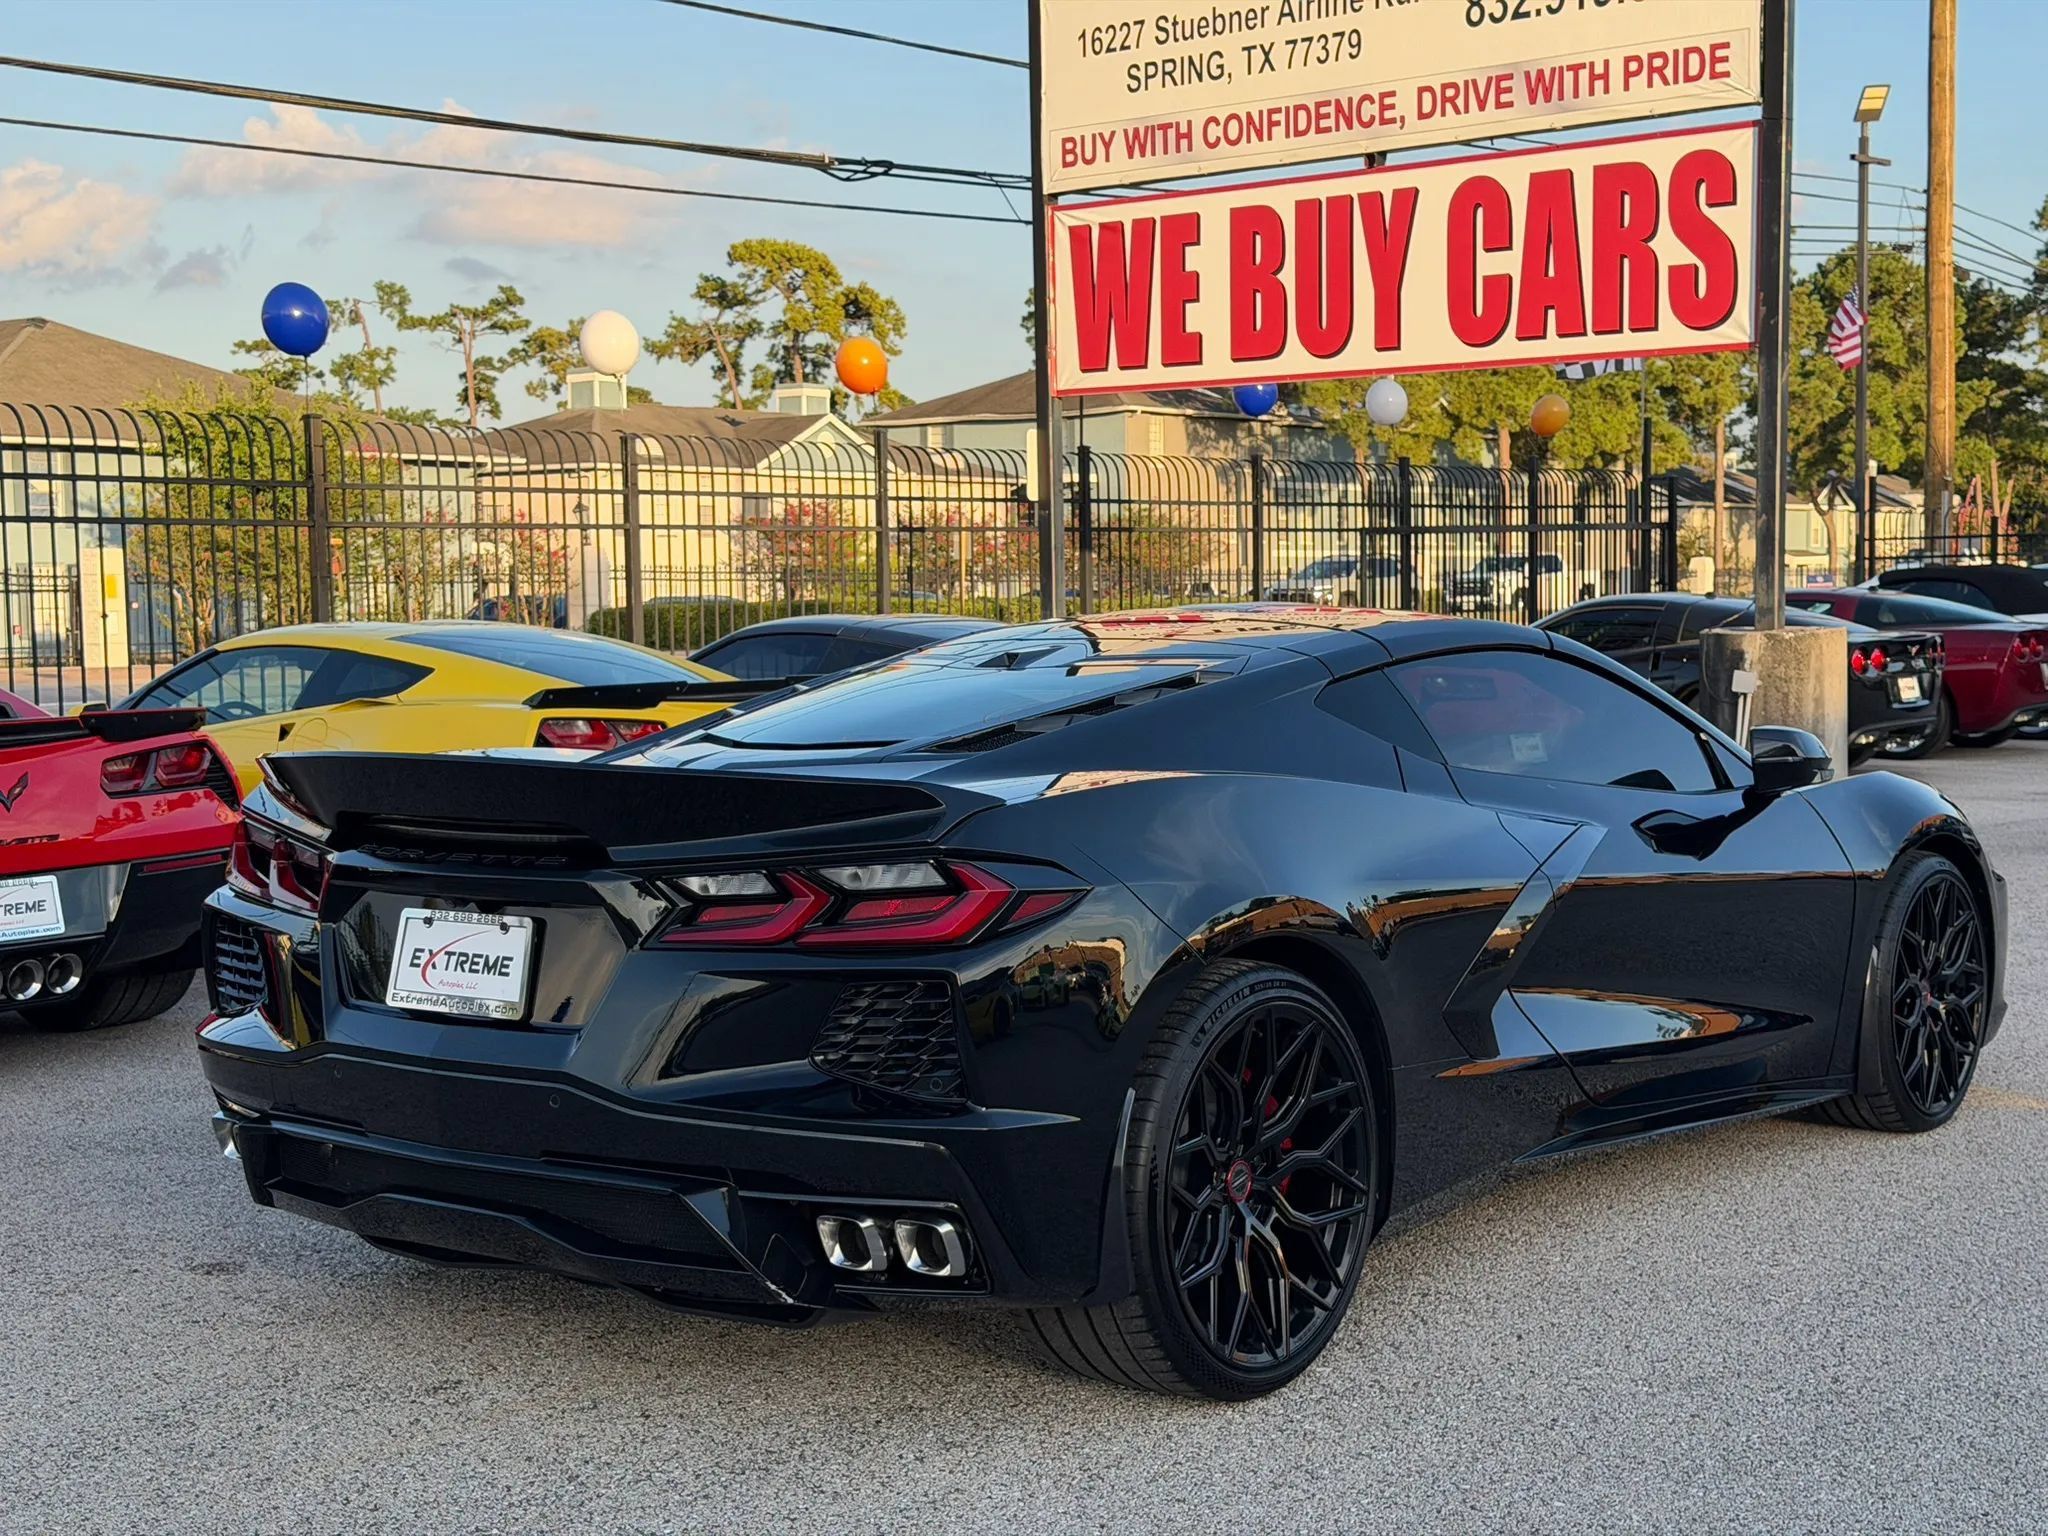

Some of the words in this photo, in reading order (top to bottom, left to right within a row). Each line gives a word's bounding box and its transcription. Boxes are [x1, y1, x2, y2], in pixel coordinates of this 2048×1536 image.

[1077, 19, 1146, 58] 16227
[1154, 5, 1270, 45] Stuebner
[1126, 51, 1233, 94] SPRING,
[1241, 41, 1276, 76] TX
[1284, 28, 1362, 70] 77379
[1061, 130, 1116, 169] BUY
[1123, 119, 1193, 160] WITH
[1202, 90, 1406, 150] CONFIDENCE,
[1416, 73, 1514, 121] DRIVE
[1524, 58, 1610, 106] WITH
[1623, 41, 1731, 92] PRIDE
[1068, 211, 1203, 374] WE
[1229, 186, 1420, 363] BUY
[1446, 148, 1738, 348] CARS
[408, 947, 515, 978] EXTREME
[391, 992, 519, 1015] ExtremeAutoplex.com
[1202, 985, 1251, 1033] MICHELIN
